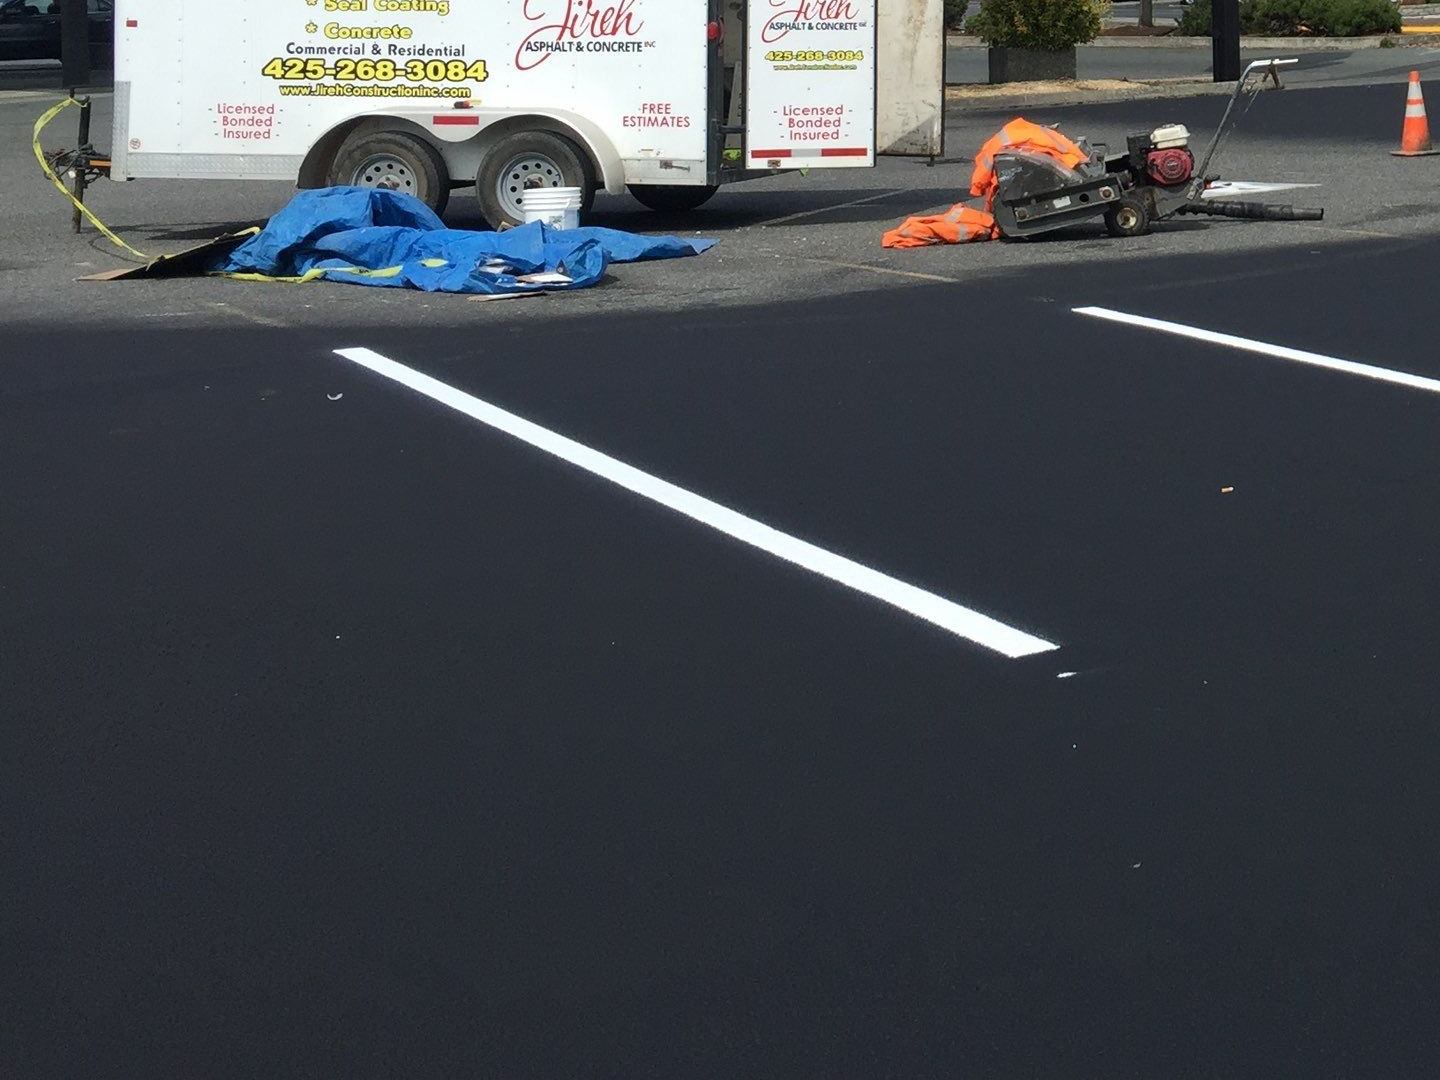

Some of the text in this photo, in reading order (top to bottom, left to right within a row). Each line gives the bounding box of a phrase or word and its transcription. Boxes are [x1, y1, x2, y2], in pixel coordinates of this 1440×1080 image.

[323, 22, 413, 39] Concrete
[769, 22, 806, 31] ASPHALT
[815, 22, 857, 31] CONCRETE
[286, 42, 465, 57] Commercial & Residential
[525, 41, 575, 52] ASPHALT
[576, 41, 584, 52] &
[586, 41, 643, 53] CONCRETE
[765, 50, 865, 61] 425-268-3084
[262, 57, 489, 82] 425-268-3084
[217, 103, 275, 115] Licensed
[641, 103, 672, 114] FREE
[783, 104, 844, 116] Licensed
[222, 116, 273, 126] Bonded
[622, 116, 690, 128] ESTIMATES
[788, 117, 841, 128] Bonded
[223, 128, 271, 139] Insured
[789, 129, 840, 140] Insured
